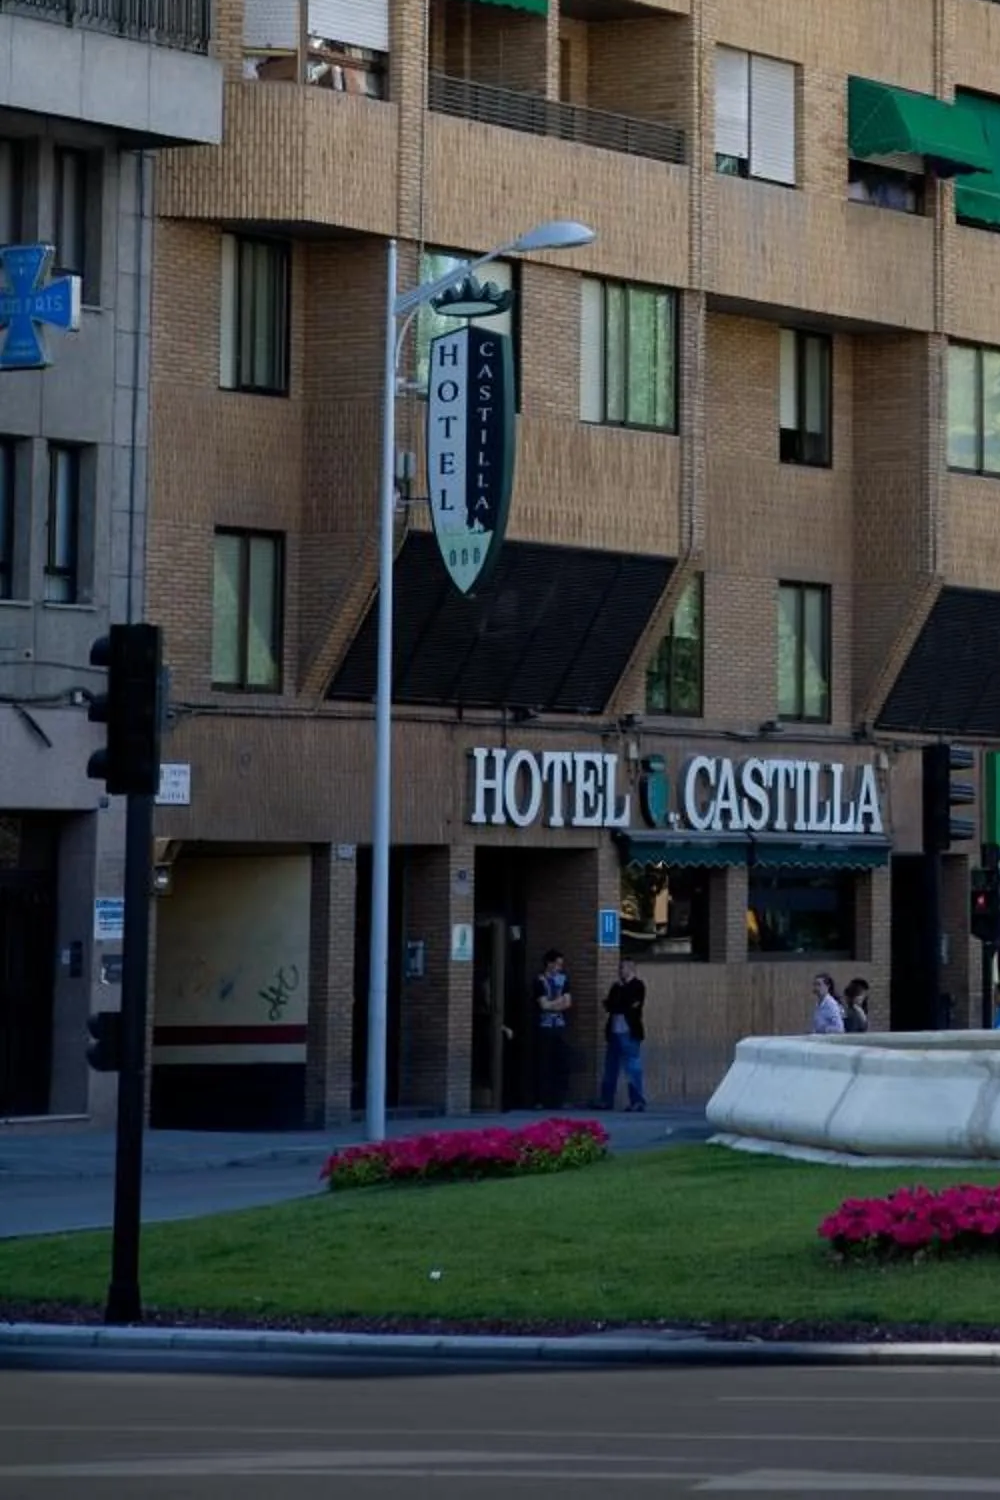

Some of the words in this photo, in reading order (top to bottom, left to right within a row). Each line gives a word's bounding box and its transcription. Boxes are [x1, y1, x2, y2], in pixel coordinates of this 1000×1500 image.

[437, 343, 460, 512] HOTEL
[475, 341, 495, 510] CASTILLA
[471, 747, 631, 827] HOTEL
[684, 755, 883, 833] CASTILLA
